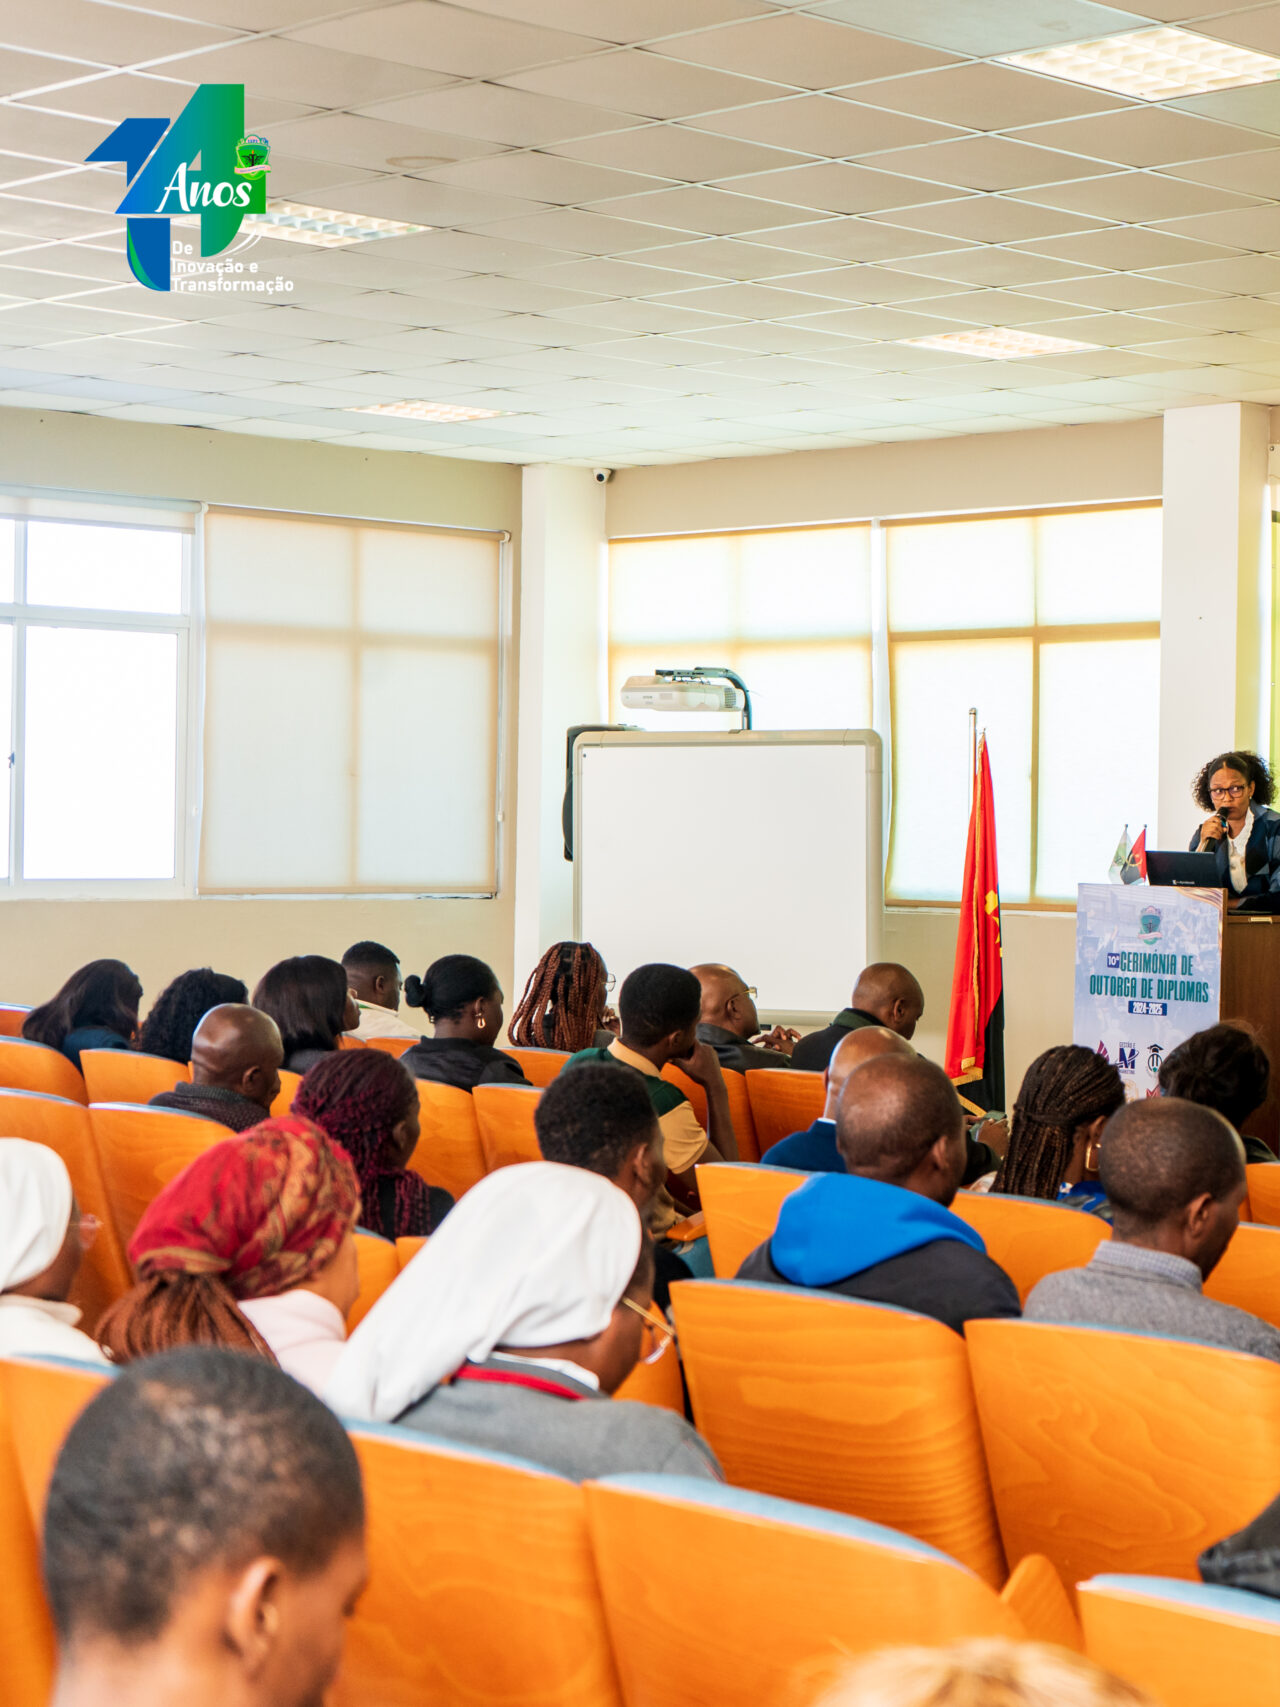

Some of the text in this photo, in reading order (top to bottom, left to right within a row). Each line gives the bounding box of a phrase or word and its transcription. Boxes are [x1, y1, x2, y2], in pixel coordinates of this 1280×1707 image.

[1120, 949, 1177, 976] CERIMÓNIA
[1181, 955, 1194, 976] DE
[1089, 975, 1209, 1003] OUTORGA DE DIPLOMAS
[1132, 1001, 1164, 1015] 2024-2025
